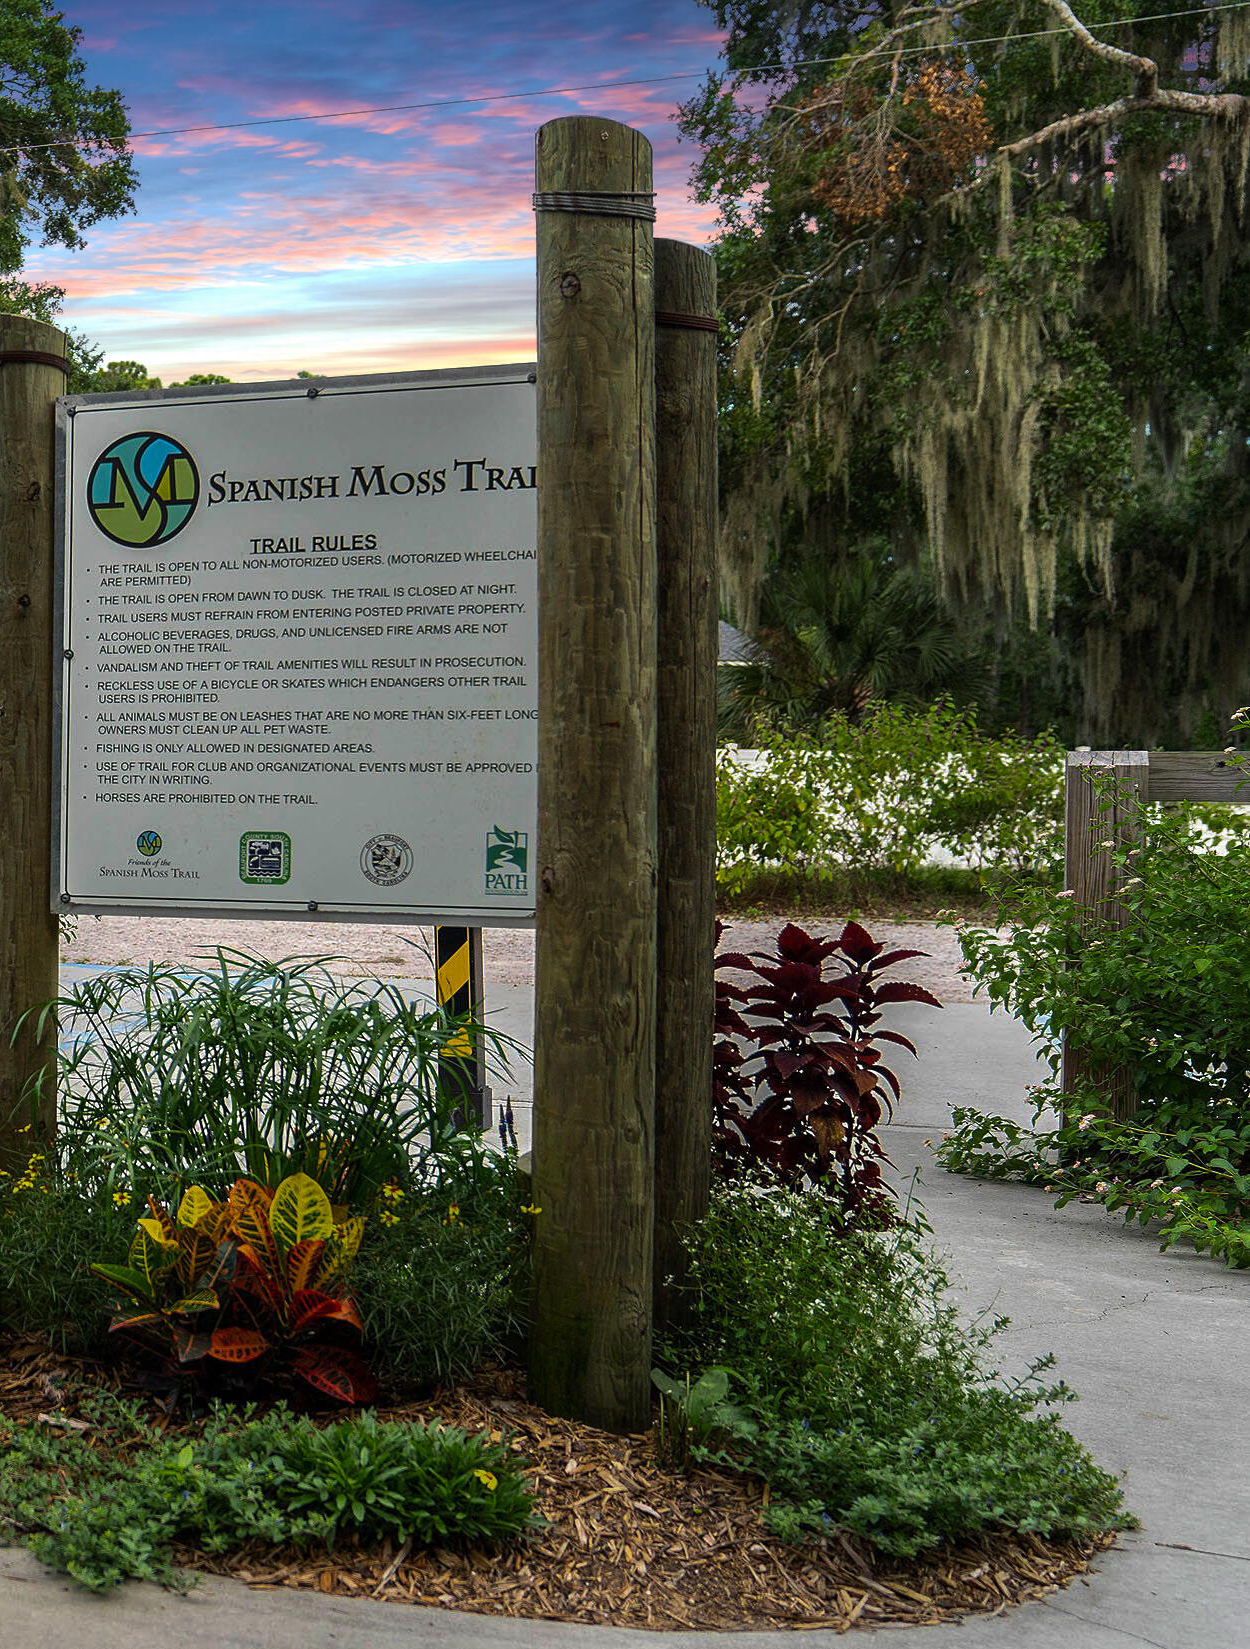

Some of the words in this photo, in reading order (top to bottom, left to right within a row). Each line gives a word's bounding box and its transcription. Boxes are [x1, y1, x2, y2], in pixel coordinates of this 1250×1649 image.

[207, 471, 340, 507] SPANISH
[346, 465, 446, 497] MOSS
[250, 538, 306, 554] TRAIL
[312, 534, 377, 552] RULES
[99, 564, 119, 574] THE
[122, 563, 152, 573] TRAIL
[156, 563, 165, 572] IS
[169, 562, 199, 572] OPEN
[202, 561, 216, 571] TO
[220, 560, 239, 570] ALL
[243, 557, 338, 569] NON-MOTORIZED
[342, 556, 384, 566] USERS.
[388, 553, 461, 565] (MOTORIZED
[100, 578, 122, 587] ARE
[126, 576, 191, 586] PERMITTED)
[99, 596, 119, 605] THE
[122, 595, 152, 604] TRAIL
[156, 594, 165, 604] IS
[168, 593, 199, 603] OPEN
[203, 592, 234, 602] FROM
[238, 591, 270, 601] DAWN
[274, 591, 288, 600] TO
[292, 590, 325, 600] DUSK.
[332, 589, 354, 599] THE
[358, 588, 390, 598] TRAIL
[394, 588, 404, 597] IS
[408, 586, 457, 597] CLOSED
[460, 585, 473, 595] AT
[478, 584, 516, 595] NIGHT.
[99, 614, 128, 623] TRAIL
[131, 613, 167, 622] USERS
[171, 612, 201, 622] MUST
[205, 610, 253, 621] REFRAIN
[257, 610, 289, 619] FROM
[293, 608, 350, 618] ENTERING
[355, 607, 402, 617] POSTED
[407, 605, 454, 616] PRIVATE
[458, 603, 526, 615] PROPERTY.
[98, 631, 159, 641] ALCOHOLIC
[163, 630, 232, 640] BEVERAGES,
[236, 629, 278, 639] DRUGS,
[281, 628, 305, 638] AND
[309, 626, 383, 637] UNLICENSED
[387, 626, 413, 635] FIRE
[416, 625, 451, 635] ARMS
[454, 624, 479, 634] ARE
[483, 624, 507, 633] NOT
[100, 645, 150, 654] ALLOWED
[154, 644, 170, 653] ON
[174, 644, 194, 653] THE
[198, 643, 230, 652] TRAIL.
[97, 663, 157, 672] VANDALISM
[160, 662, 183, 671] AND
[186, 662, 220, 671] THEFT
[224, 662, 239, 670] OF
[242, 661, 273, 670] TRAIL
[277, 660, 338, 670] AMENITIES
[342, 659, 367, 669] WILL
[372, 658, 416, 668] RESULT
[420, 658, 431, 667] IN
[435, 657, 526, 667] PROSECUTION.
[98, 681, 154, 690] RECKLESS
[158, 681, 180, 690] USE
[183, 681, 197, 689] OF
[200, 680, 208, 689] A
[212, 680, 258, 689] BICYCLE
[262, 680, 278, 689] OR
[282, 679, 325, 688] SKATES
[329, 678, 366, 688] WHICH
[371, 677, 444, 688] ENDANGERS
[448, 677, 489, 686] OTHER
[493, 676, 526, 686] TRAIL
[99, 694, 135, 703] USERS
[139, 694, 148, 703] IS
[152, 694, 219, 703] PROHIBITED.
[96, 712, 115, 721] ALL
[118, 712, 166, 721] ANIMALS
[169, 712, 199, 721] MUST
[203, 712, 217, 721] BE
[220, 712, 237, 721] ON
[241, 712, 291, 720] LEASHES
[295, 711, 323, 720] THAT
[326, 711, 349, 720] ARE
[353, 711, 370, 720] NO
[374, 711, 408, 720] MORE
[412, 711, 443, 720] THAN
[448, 710, 502, 720] SIX-FEET
[100, 726, 146, 734] OWNERS
[149, 726, 179, 734] MUST
[183, 725, 219, 734] CLEAN
[224, 725, 237, 734] UP
[240, 725, 260, 734] ALL
[264, 725, 286, 734] PET
[288, 725, 331, 734] WASTE.
[96, 744, 139, 753] FISHING
[143, 744, 152, 753] IS
[156, 744, 183, 753] ONLY
[186, 744, 240, 753] ALLOWED
[244, 744, 254, 753] IN
[258, 744, 332, 753] DESIGNATED
[333, 744, 374, 753] AREAS.
[96, 762, 117, 771] USE
[121, 762, 135, 771] OF
[139, 762, 168, 771] TRAIL
[172, 762, 194, 771] FOR
[198, 762, 226, 771] CLUB
[230, 762, 253, 771] AND
[257, 763, 355, 772] ORGANIZATIONAL
[360, 763, 406, 772] EVENTS
[410, 763, 443, 772] MUST
[447, 763, 462, 772] BE
[465, 763, 532, 772] APPROVED
[98, 775, 118, 784] THE
[122, 775, 146, 784] CITY
[150, 775, 159, 784] IN
[163, 775, 212, 784] WRITING.
[96, 794, 140, 802] HORSES
[143, 794, 165, 803] ARE
[169, 794, 235, 803] PROHIBITED
[239, 794, 255, 803] ON
[258, 794, 280, 804] THE
[283, 794, 317, 804] TRAIL.
[152, 858, 161, 867] of
[100, 866, 138, 877] SPANISH
[141, 868, 168, 878] MOSS
[171, 868, 200, 878] TRAIL
[484, 874, 527, 890] PATH
